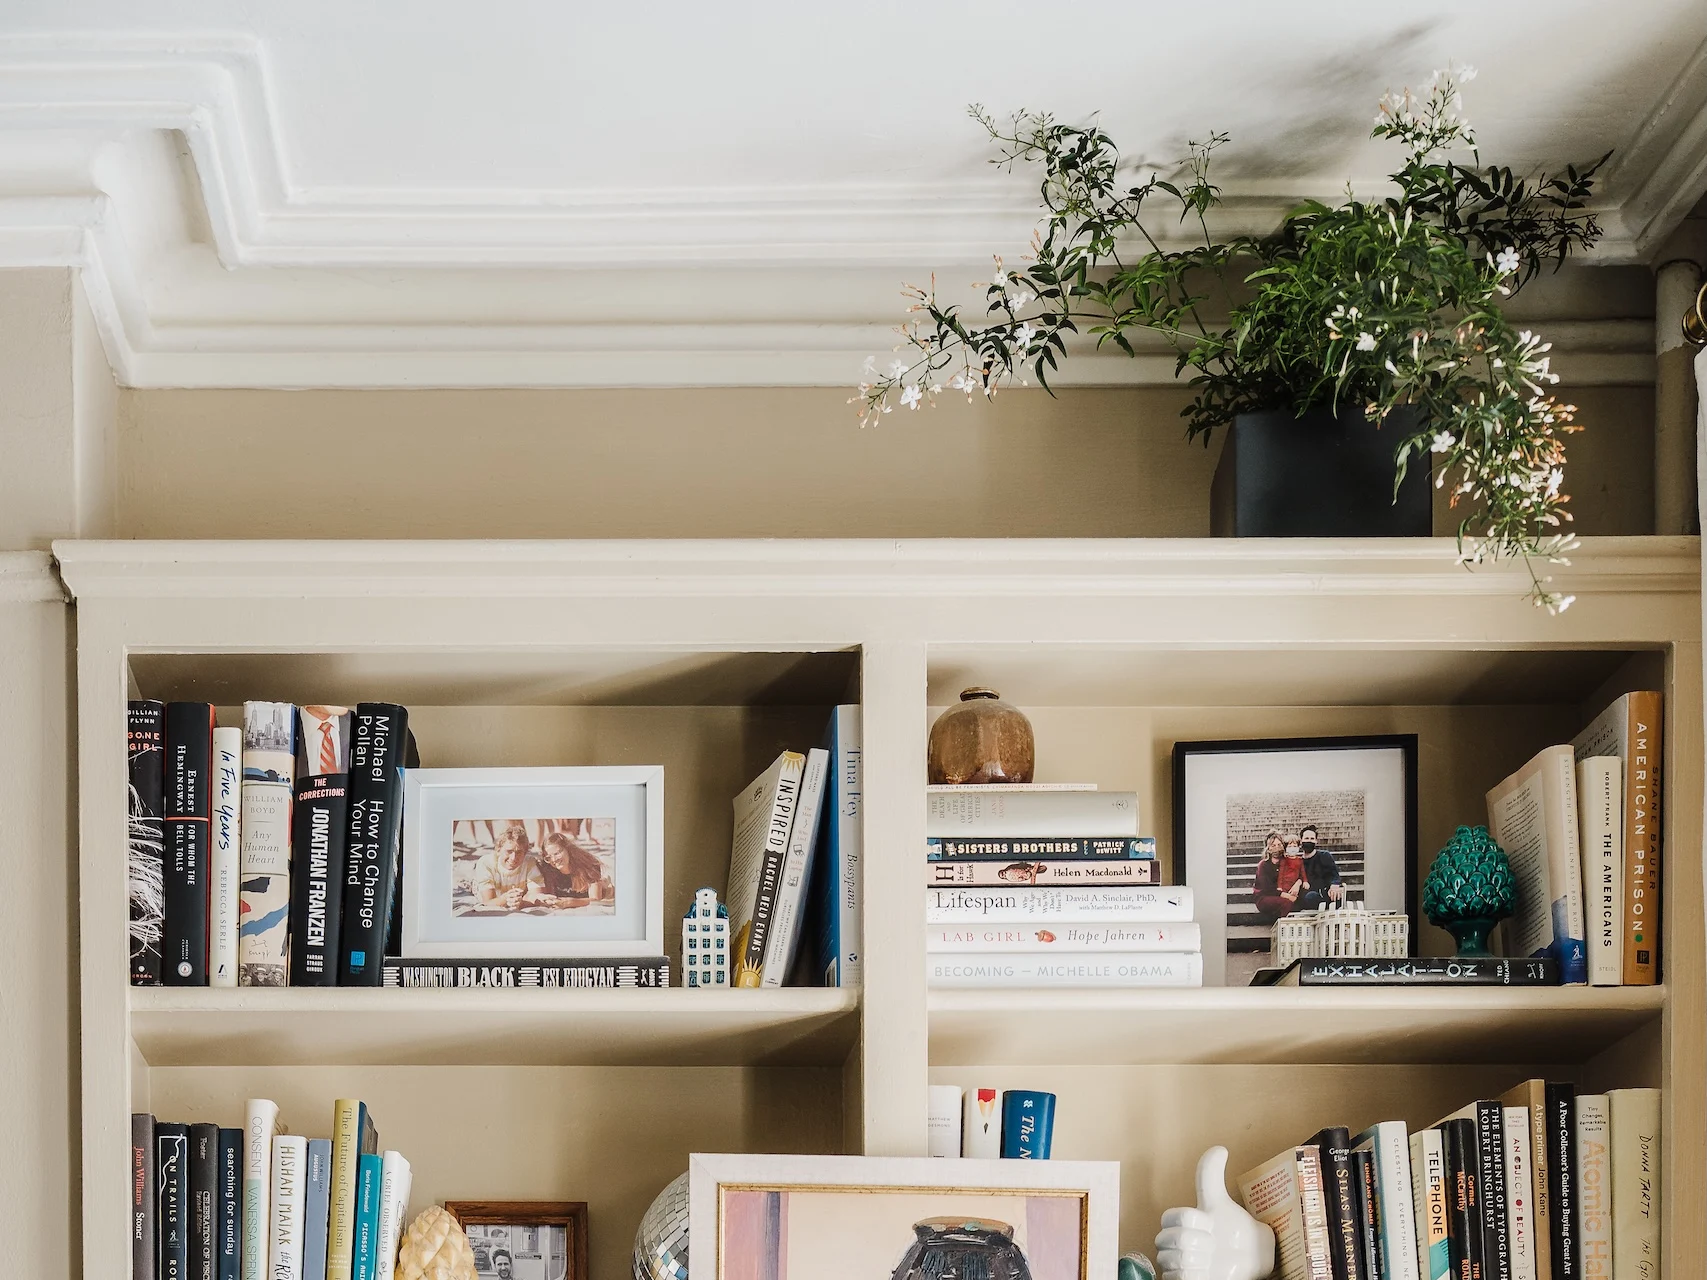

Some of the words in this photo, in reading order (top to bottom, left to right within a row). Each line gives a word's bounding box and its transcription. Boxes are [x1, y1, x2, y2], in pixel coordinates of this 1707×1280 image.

[128, 732, 160, 740] GONE
[129, 743, 157, 751] GIRL
[356, 715, 372, 766] Pollan
[371, 715, 390, 783] Michael
[176, 745, 186, 812] HEMINGWAY
[187, 770, 196, 812] ERNEST
[314, 778, 326, 787] THE
[1634, 722, 1648, 835] AMERICAN
[244, 796, 283, 804] WILLIAM
[299, 788, 344, 800] CORRECTIONS
[350, 800, 367, 839] Your
[369, 800, 384, 840] How
[769, 779, 796, 846] INSPIRED
[176, 824, 184, 844] BELL
[188, 824, 196, 838] FOR
[310, 806, 330, 878] JONATHAN
[1603, 834, 1612, 858] THE
[176, 848, 184, 872] TOLLS
[188, 840, 196, 864] WHOM
[244, 842, 280, 852] Human
[248, 854, 275, 864] Heart
[366, 844, 376, 860] to
[958, 843, 1008, 854] SISTERS
[1013, 842, 1078, 854] BROTHERS
[188, 868, 196, 886] THE
[348, 842, 364, 886] Mind
[763, 857, 777, 891] RACHEL
[936, 865, 954, 882] H
[1053, 867, 1081, 878] Helen
[1085, 866, 1132, 878] Macdonald
[844, 853, 858, 910] Bossypants
[1632, 850, 1645, 931] PRISON
[361, 864, 379, 930] Change
[758, 895, 770, 919] HELD
[935, 891, 1017, 914] Lifespan
[1603, 864, 1612, 948] AMERICANS
[307, 880, 328, 948] FRANZEN
[752, 922, 765, 952] EVANS
[943, 932, 974, 942] LAB
[984, 932, 1026, 942] GIRL
[1068, 930, 1100, 944] Hope
[1103, 930, 1146, 942] Jahren
[402, 967, 454, 987] WASHINGTON
[457, 966, 515, 987] BLACK
[543, 967, 561, 987] ESI
[563, 967, 615, 987] EDUGYAN
[934, 966, 1014, 977] BECOMING
[1038, 966, 1110, 976] MICHELLE
[1118, 966, 1172, 976] OBAMA
[1311, 963, 1478, 978] EXHALATION
[1021, 1116, 1035, 1142] The
[1480, 1108, 1490, 1149] ROBERT
[1492, 1107, 1500, 1121] THE
[134, 1146, 145, 1171] John
[251, 1116, 262, 1176] CONSENT
[1329, 1148, 1350, 1156] George
[1334, 1154, 1348, 1162] Eliot
[1493, 1124, 1502, 1190] ELEMENTS
[1638, 1134, 1653, 1173] DONNA
[225, 1148, 236, 1198] searching
[1580, 1139, 1606, 1233] Atomic
[135, 1173, 145, 1205] Williams
[1336, 1168, 1349, 1211] SILAS
[1428, 1150, 1443, 1236] TELEPHONE
[1456, 1170, 1465, 1212] McCarthy
[1484, 1152, 1494, 1229] BRINGHURST
[1638, 1177, 1651, 1218] TARTT
[227, 1201, 236, 1217] for
[246, 1187, 259, 1243] VANESSA
[136, 1212, 145, 1240] Stoner
[225, 1220, 234, 1255] sunday
[360, 1222, 369, 1262] PICASSO'S
